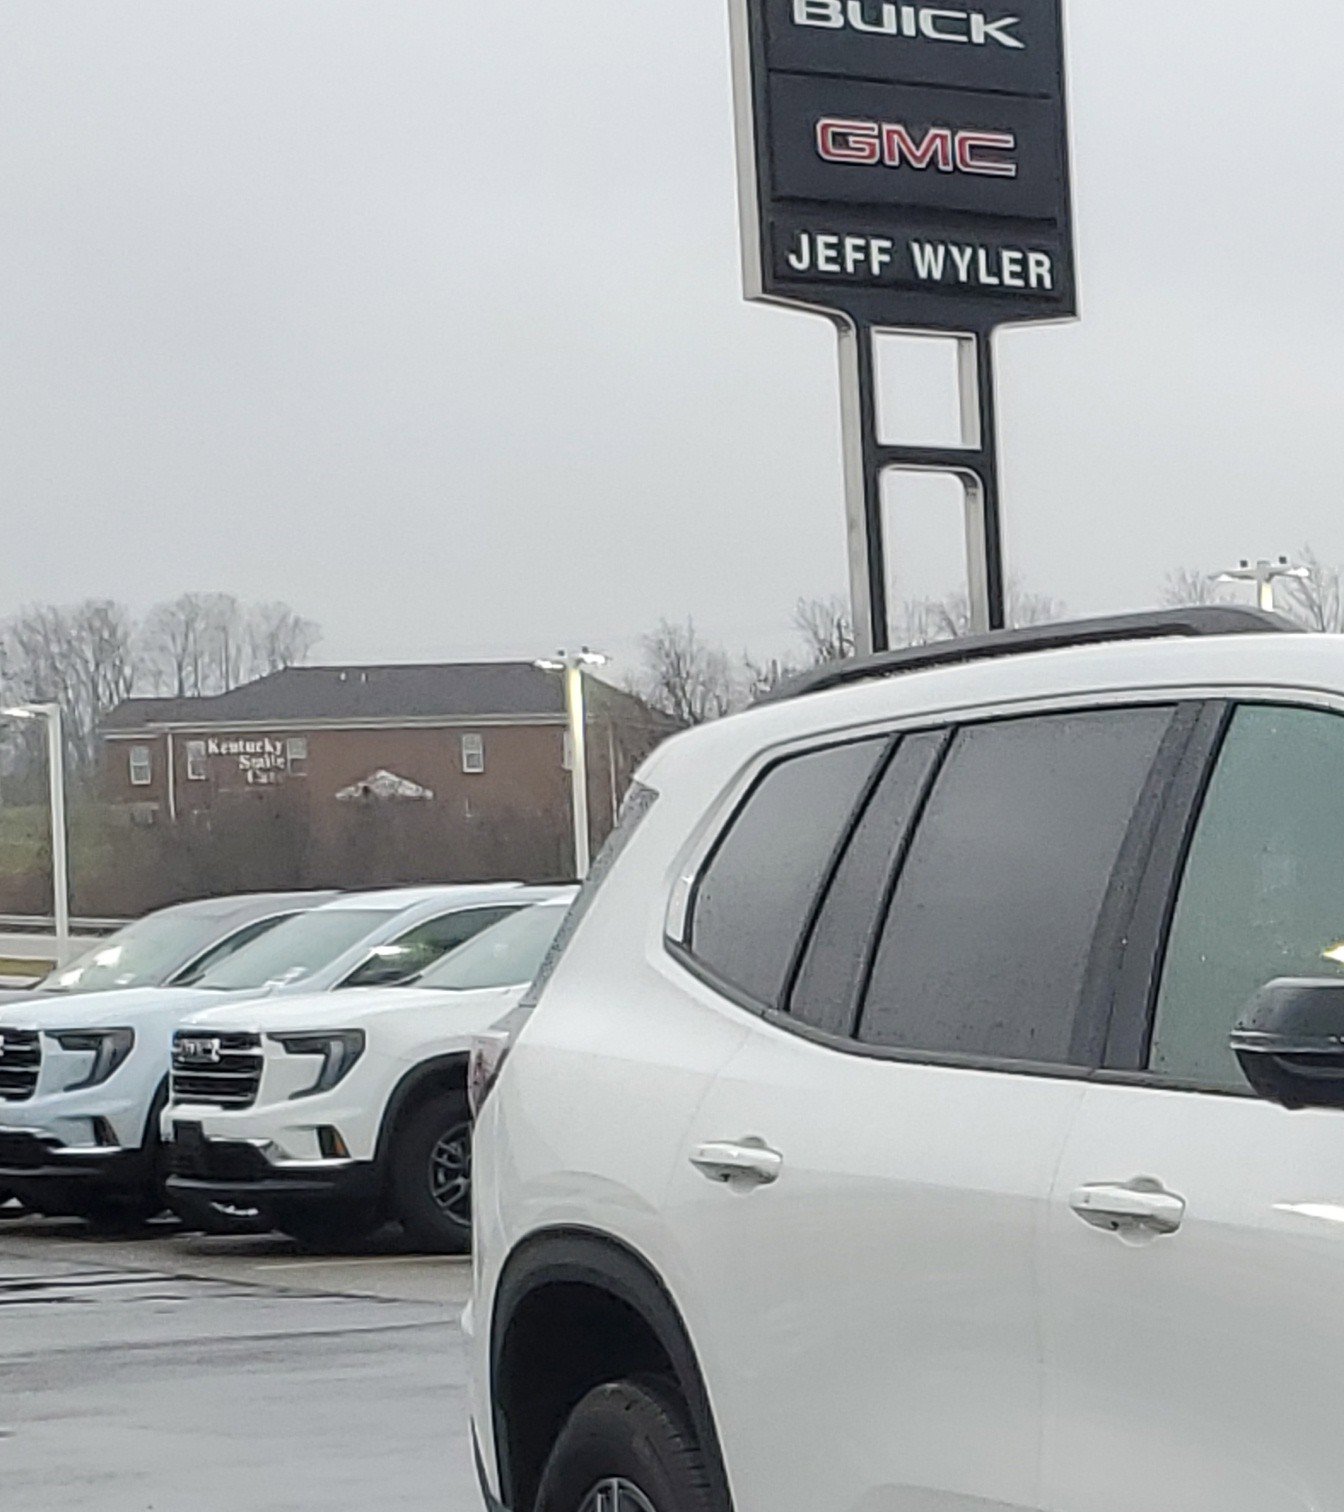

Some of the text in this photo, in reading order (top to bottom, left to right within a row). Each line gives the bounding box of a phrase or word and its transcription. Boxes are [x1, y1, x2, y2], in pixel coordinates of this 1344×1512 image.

[794, 0, 1026, 49] BUICK
[816, 117, 1018, 178] GMC
[788, 233, 1054, 290] JEFF WYLER
[208, 738, 282, 755] Kentucky
